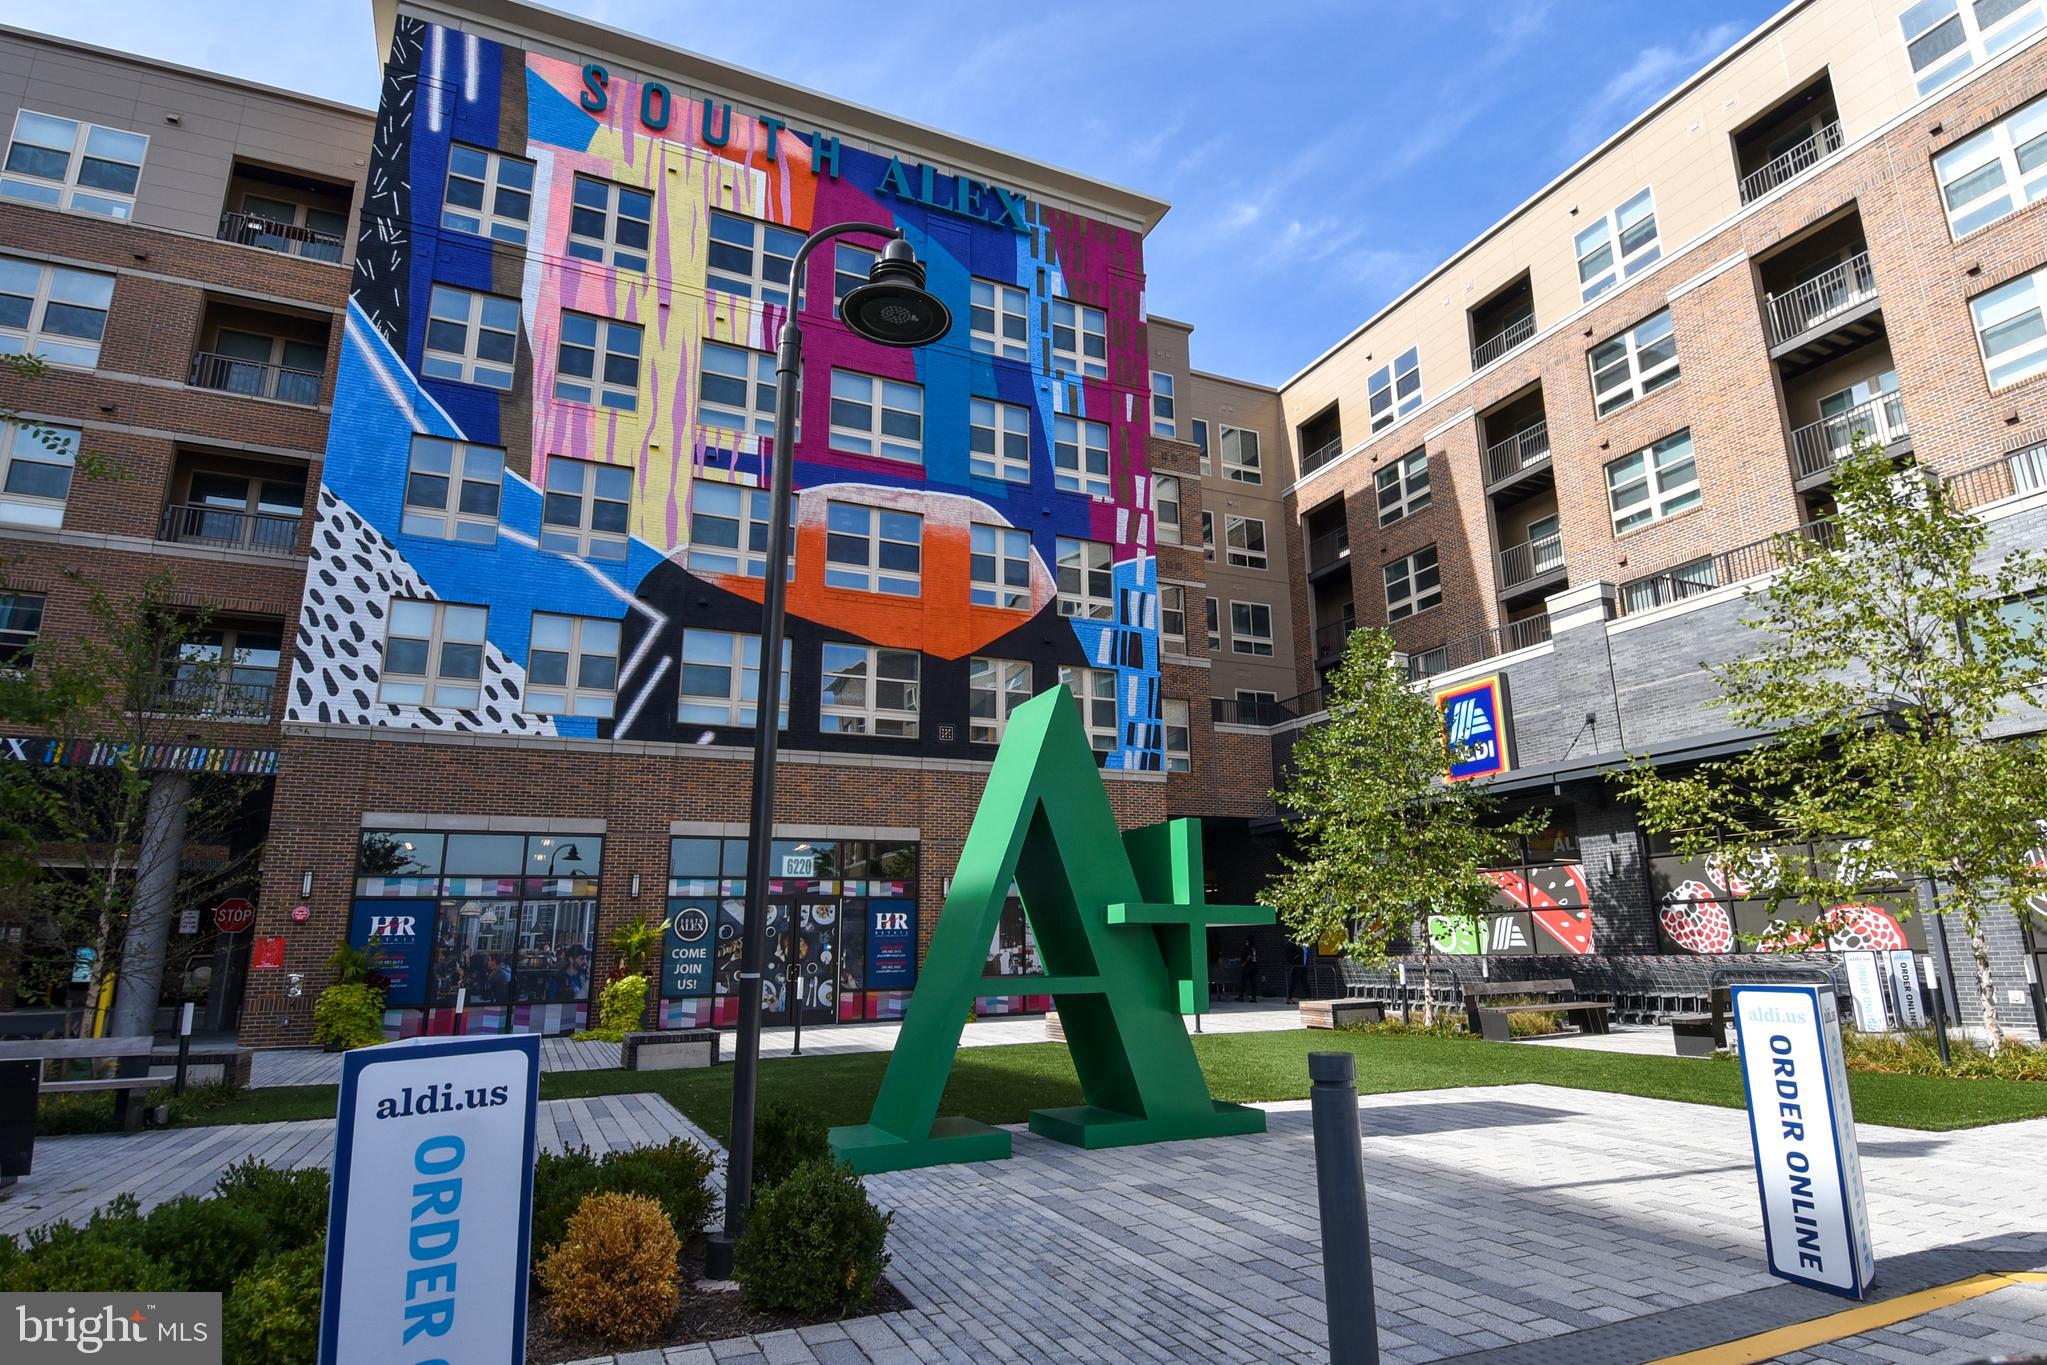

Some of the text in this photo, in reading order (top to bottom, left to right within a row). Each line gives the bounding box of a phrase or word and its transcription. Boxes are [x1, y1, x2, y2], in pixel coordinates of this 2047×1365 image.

[580, 64, 1032, 234] SOUTH ALEX
[787, 858, 812, 875] 6220
[218, 909, 252, 922] STOP
[875, 912, 909, 930] HR
[368, 916, 416, 936] HR
[679, 923, 704, 931] ALEX
[671, 948, 708, 959] COME
[673, 963, 702, 975] JOIN
[677, 979, 697, 990] US!
[1900, 962, 1919, 1026] ORDER ONLINE
[1748, 1006, 1807, 1025] aldi.us
[376, 1083, 509, 1120] aldi.us
[1770, 1034, 1824, 1273] ORDER ONLINE
[1831, 1034, 1872, 1275] ORDER ONLINE
[402, 1135, 466, 1346] ORDER
